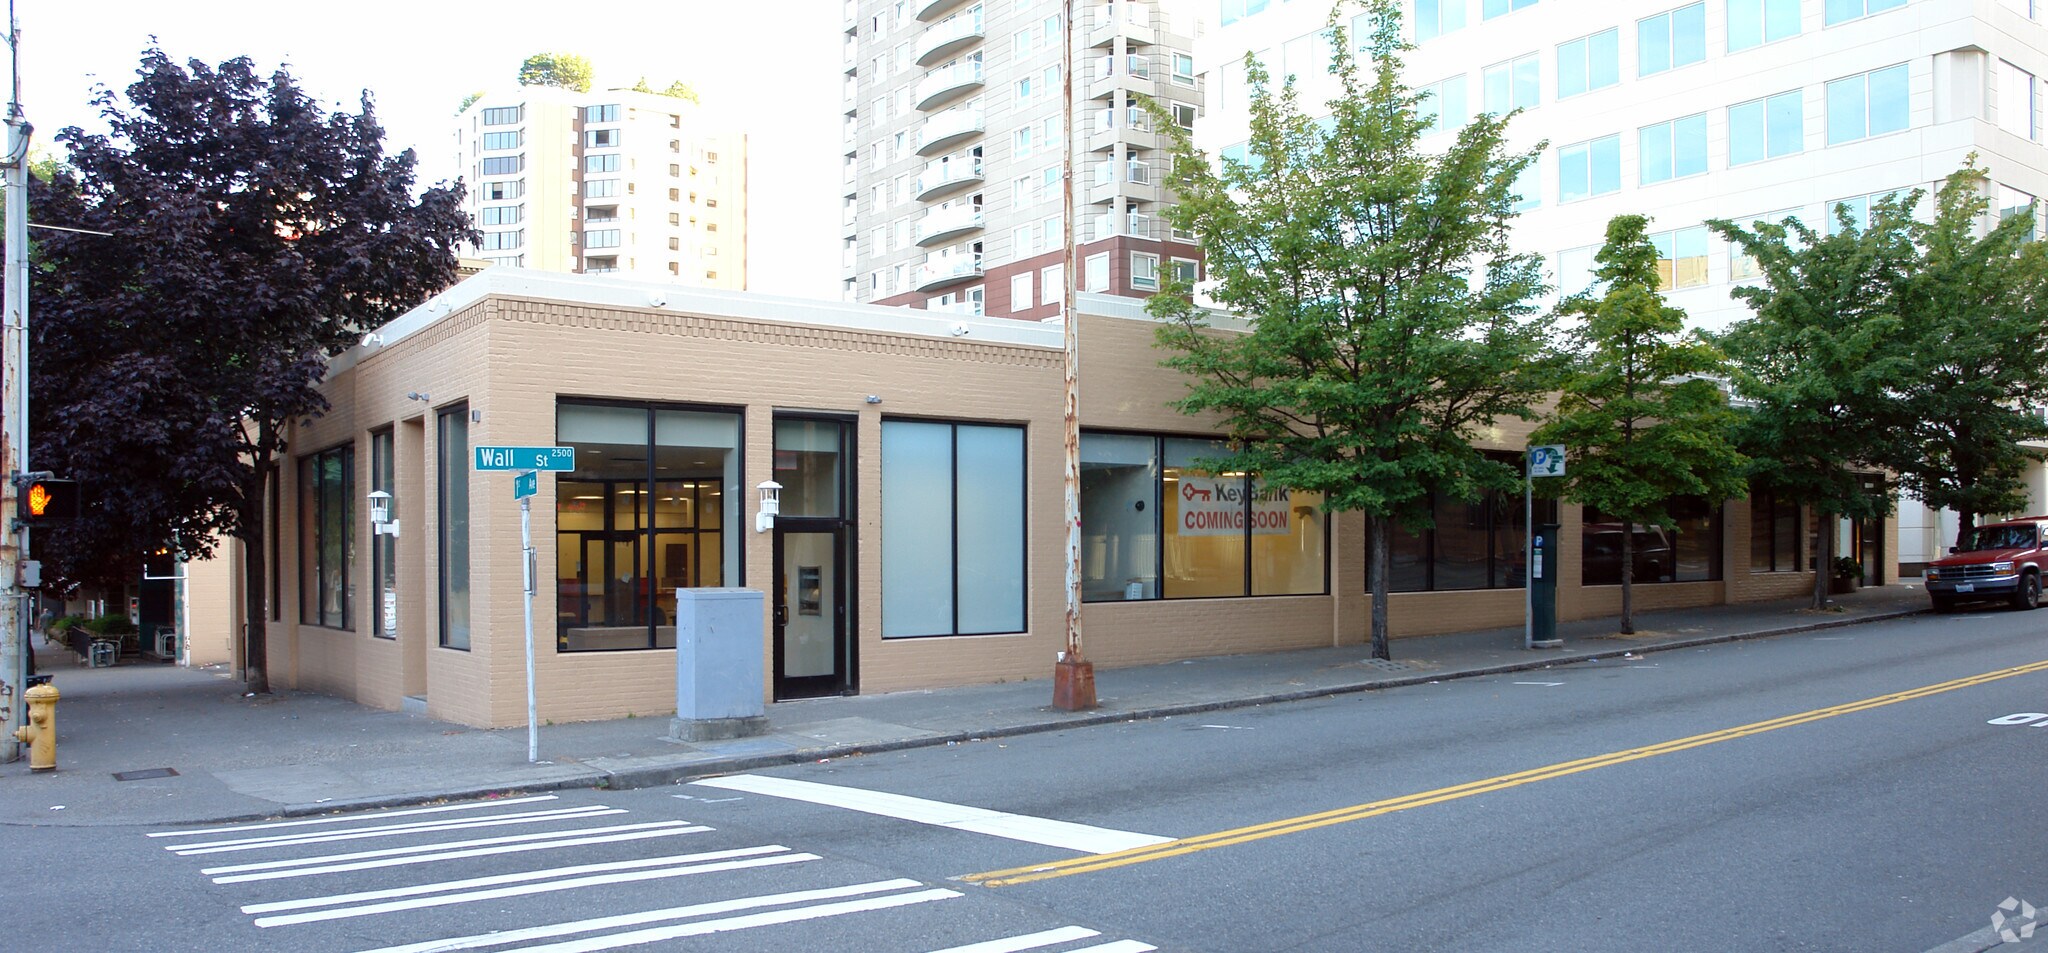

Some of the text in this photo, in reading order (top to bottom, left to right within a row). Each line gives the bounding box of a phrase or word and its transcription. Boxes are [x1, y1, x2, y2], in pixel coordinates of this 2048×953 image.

[480, 448, 549, 467] Wall St
[551, 449, 572, 458] 2500
[1536, 451, 1544, 463] P
[1184, 511, 1288, 529] COMING SOON
[1536, 535, 1543, 547] P
